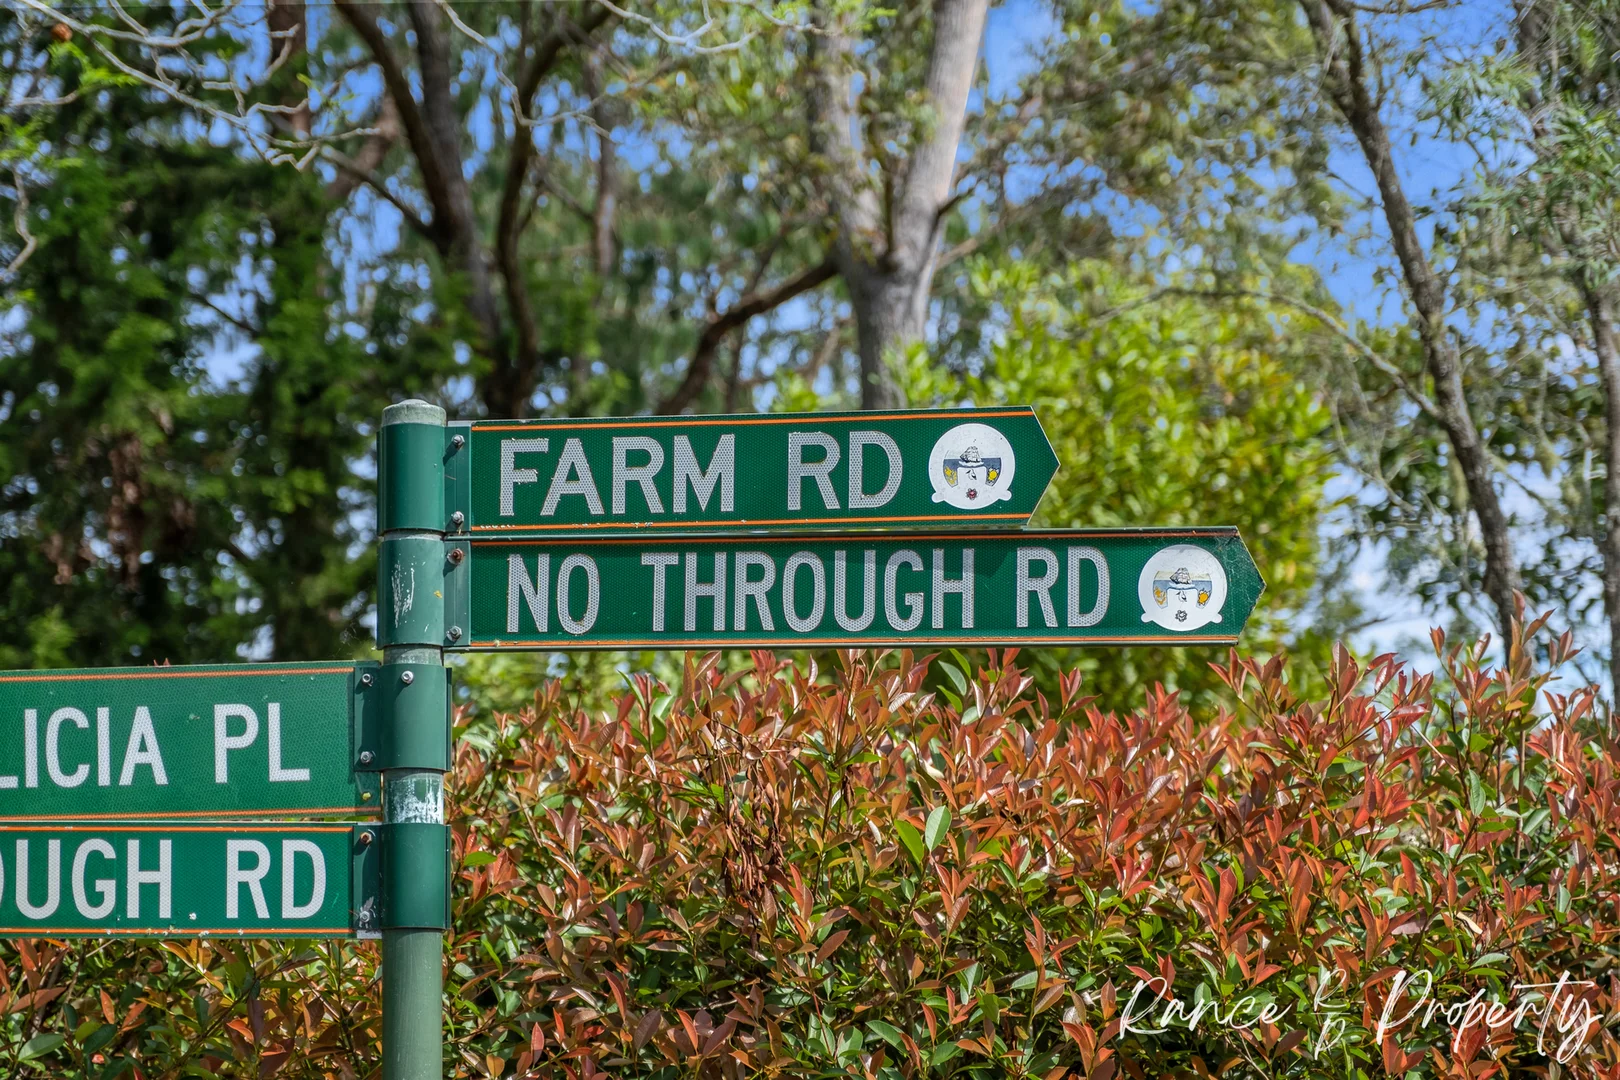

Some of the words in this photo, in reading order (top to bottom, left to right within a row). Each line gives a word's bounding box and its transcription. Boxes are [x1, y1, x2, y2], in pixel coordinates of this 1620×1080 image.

[500, 433, 735, 516] FARM
[787, 430, 903, 511] RD
[506, 553, 601, 636] NO
[641, 547, 976, 634] THROUGH
[1016, 546, 1112, 630] RD
[214, 702, 311, 784] PL
[0, 838, 173, 920] UGH
[226, 838, 328, 920] RD
